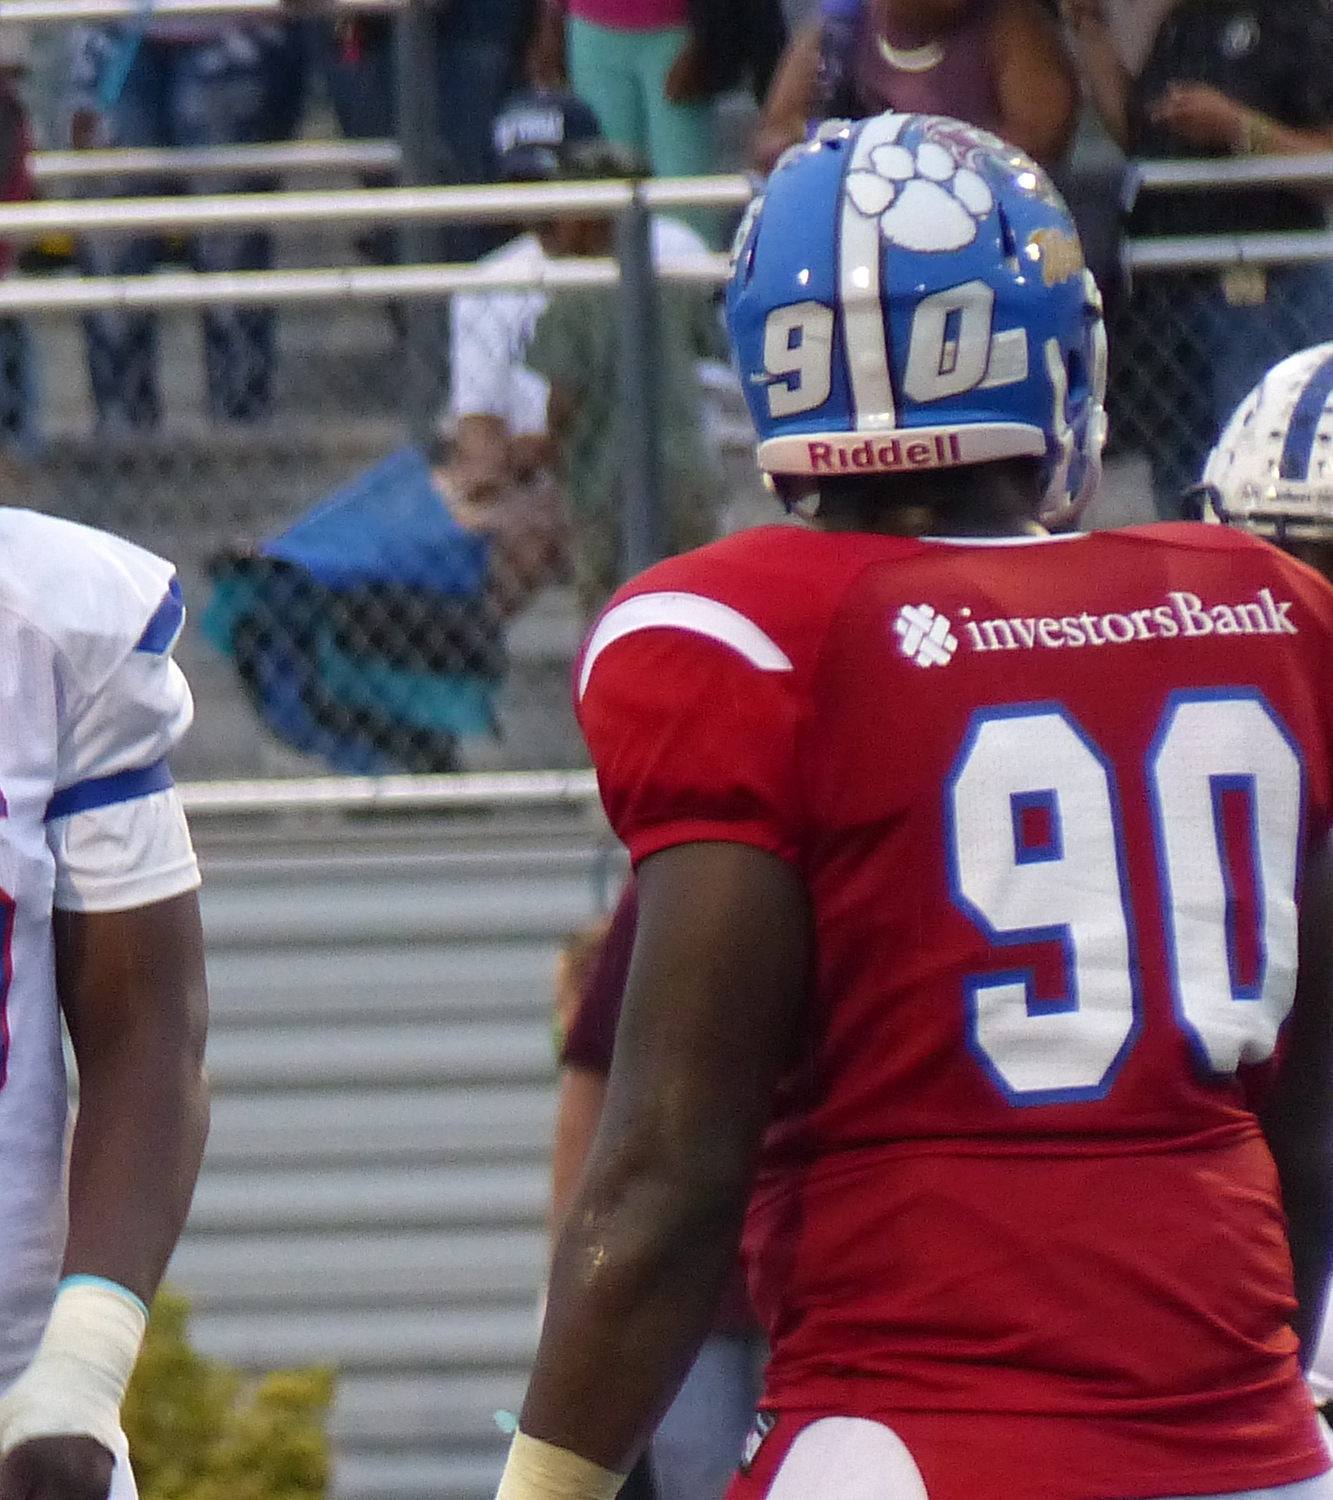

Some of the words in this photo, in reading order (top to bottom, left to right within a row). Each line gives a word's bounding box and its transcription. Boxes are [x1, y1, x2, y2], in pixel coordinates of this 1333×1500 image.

[807, 433, 962, 471] Riddell
[959, 588, 1299, 652] investorsBank
[945, 686, 1308, 1108] 90
